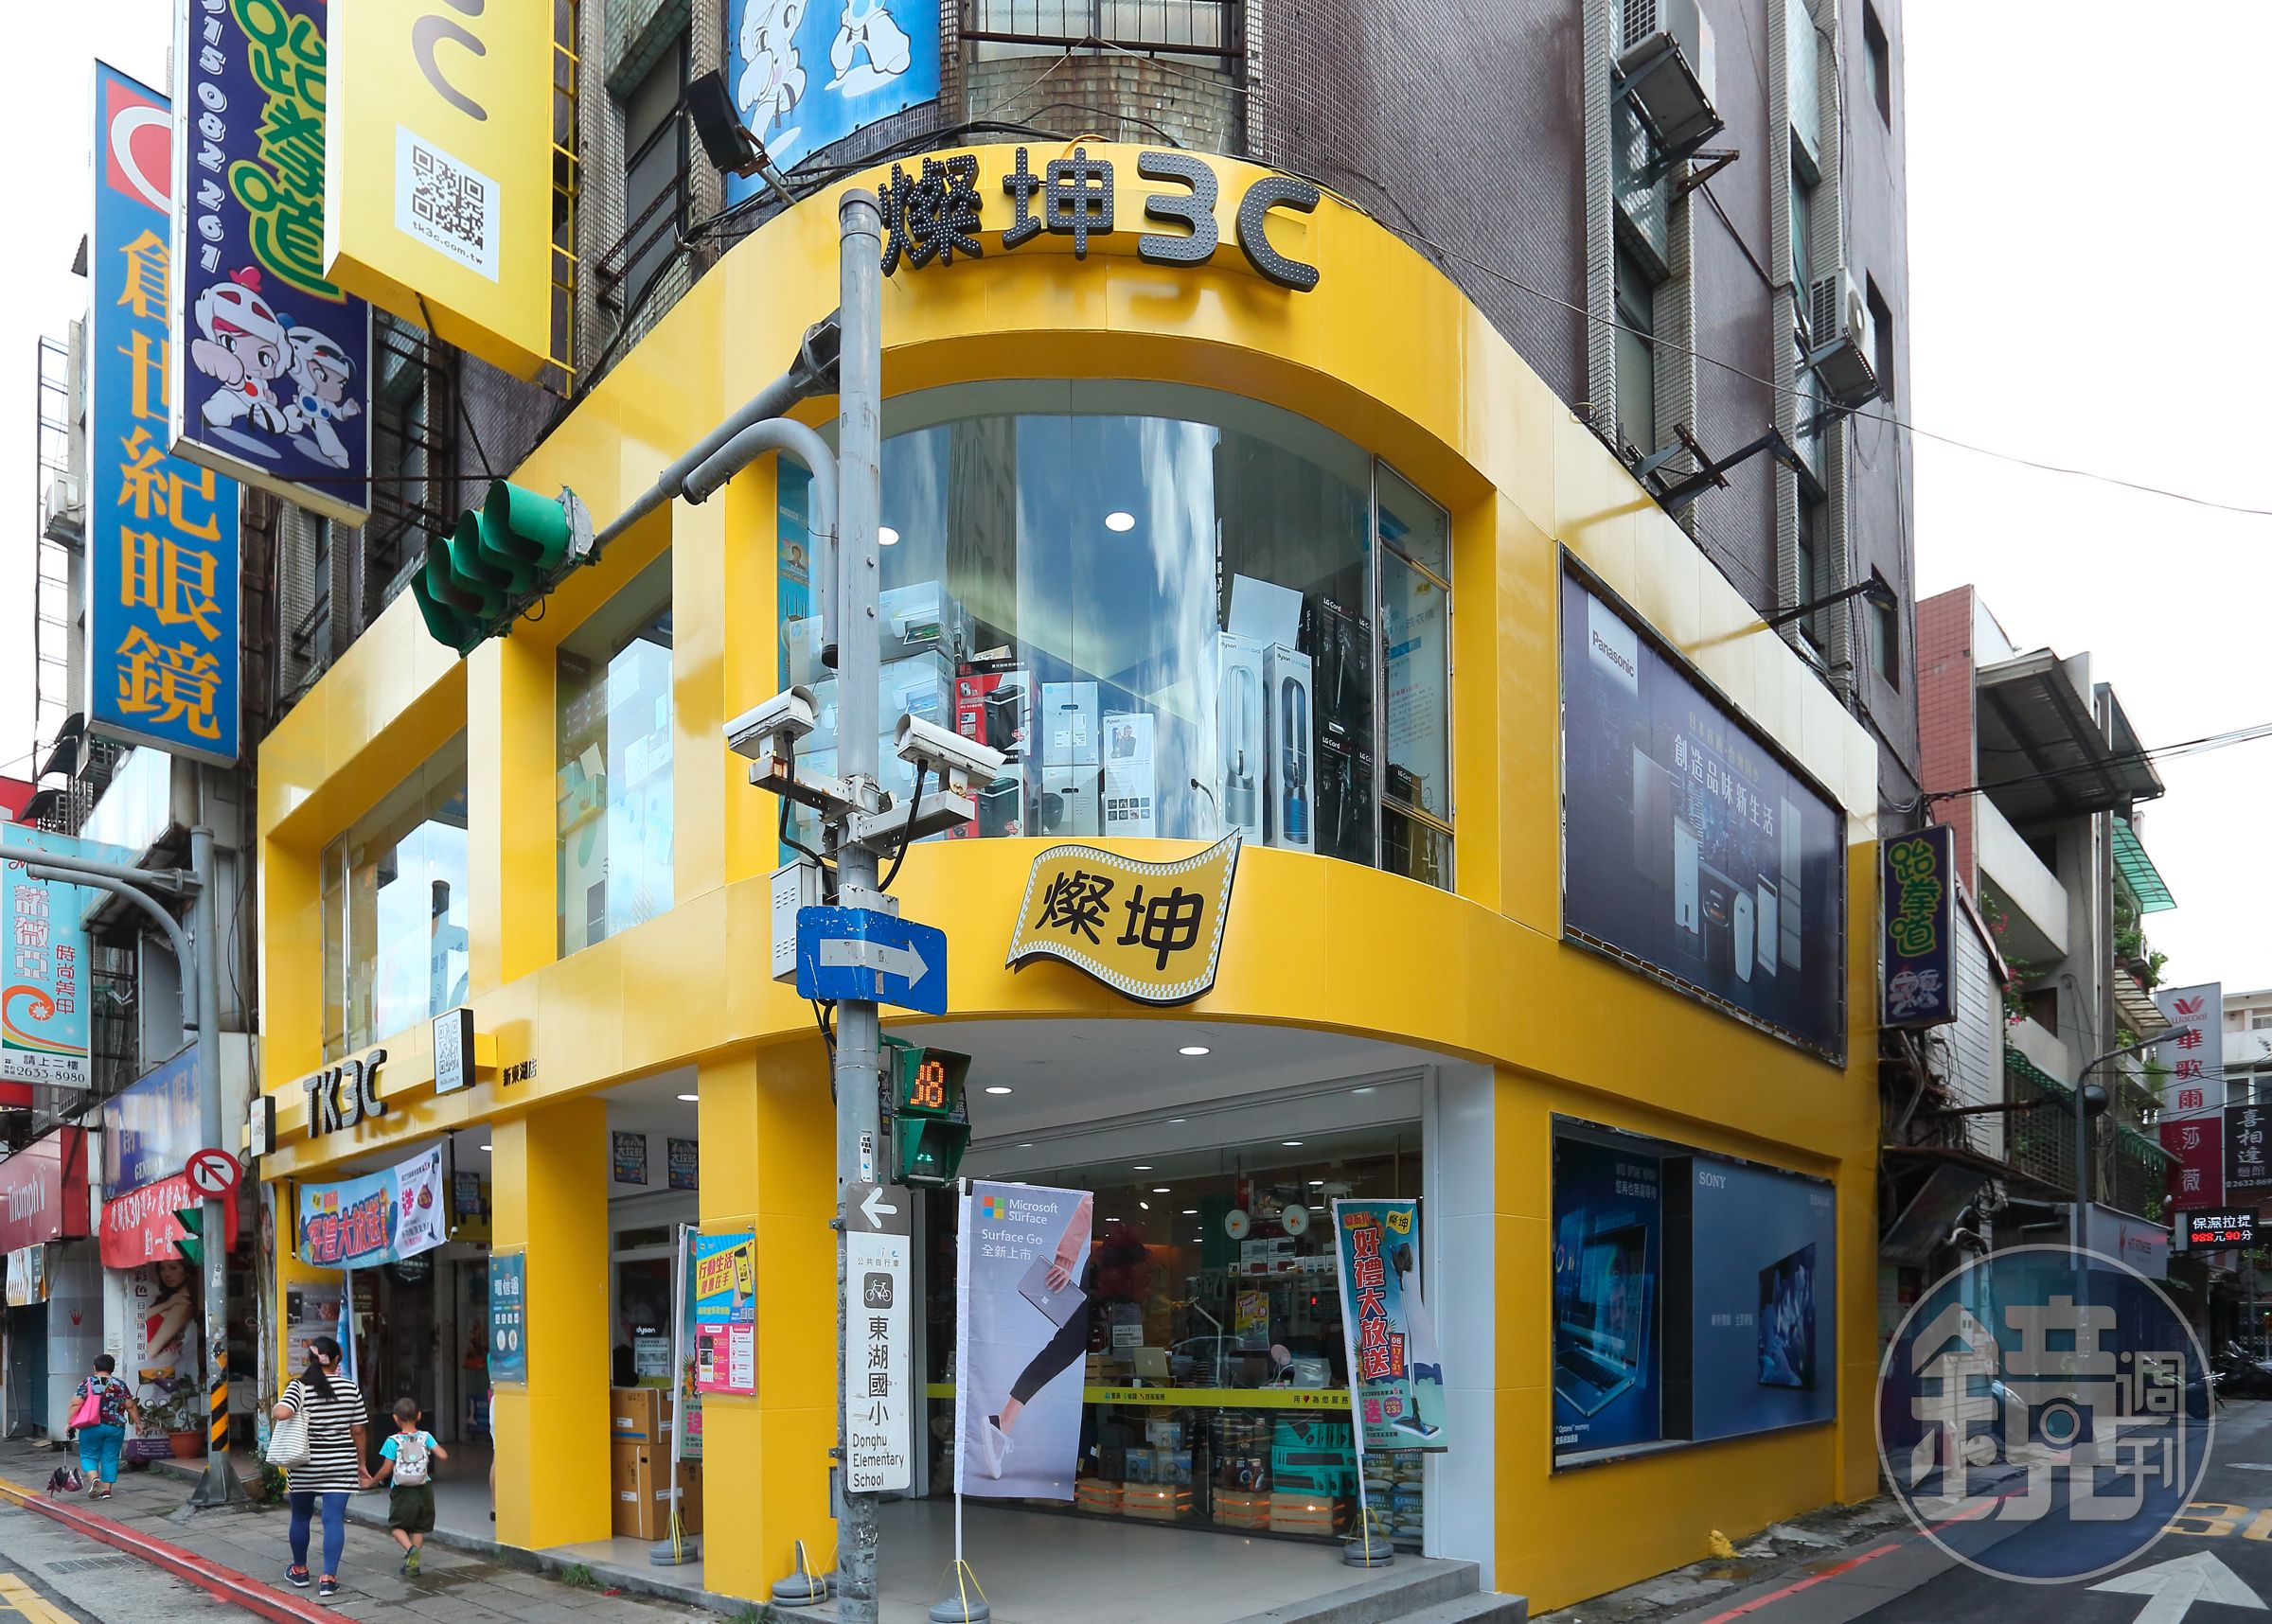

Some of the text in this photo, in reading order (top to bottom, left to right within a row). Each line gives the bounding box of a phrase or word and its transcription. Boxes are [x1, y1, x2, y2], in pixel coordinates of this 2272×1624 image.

[878, 146, 1322, 293] 燦坤3C
[412, 219, 484, 266] tk3c.com.tw
[1220, 642, 1237, 650] dyson
[1277, 652, 1291, 662] dyson
[1592, 628, 1635, 679] Panasonic
[1674, 733, 1774, 838] 創造品味新生活
[1889, 838, 1941, 958] 跆拳道
[1035, 869, 1205, 972] 燦坤
[16, 1067, 85, 1083] 2633-8980
[503, 1057, 537, 1087] 新東湖店
[2174, 1028, 2204, 1110] 華歌爾
[303, 1049, 387, 1139] TK3C
[2181, 1125, 2201, 1193] 莎薇
[1698, 1172, 1727, 1190] SONY
[7, 1173, 40, 1227] Triumph
[1009, 1198, 1058, 1214] Microsoft
[306, 1195, 383, 1263] 好禮大放送
[1008, 1210, 1048, 1225] Surface
[1388, 1213, 1409, 1230] 燦坤
[981, 1228, 1043, 1245] Surface Go
[857, 1257, 900, 1267] 公共自行車
[981, 1244, 1032, 1261] 全新上市
[1353, 1227, 1391, 1379] 好禮大放送
[635, 1325, 656, 1335] dyson
[867, 1315, 889, 1426] 東湖國小
[852, 1432, 887, 1451] Donghu
[853, 1451, 905, 1469] Elementary
[853, 1472, 884, 1487] School
